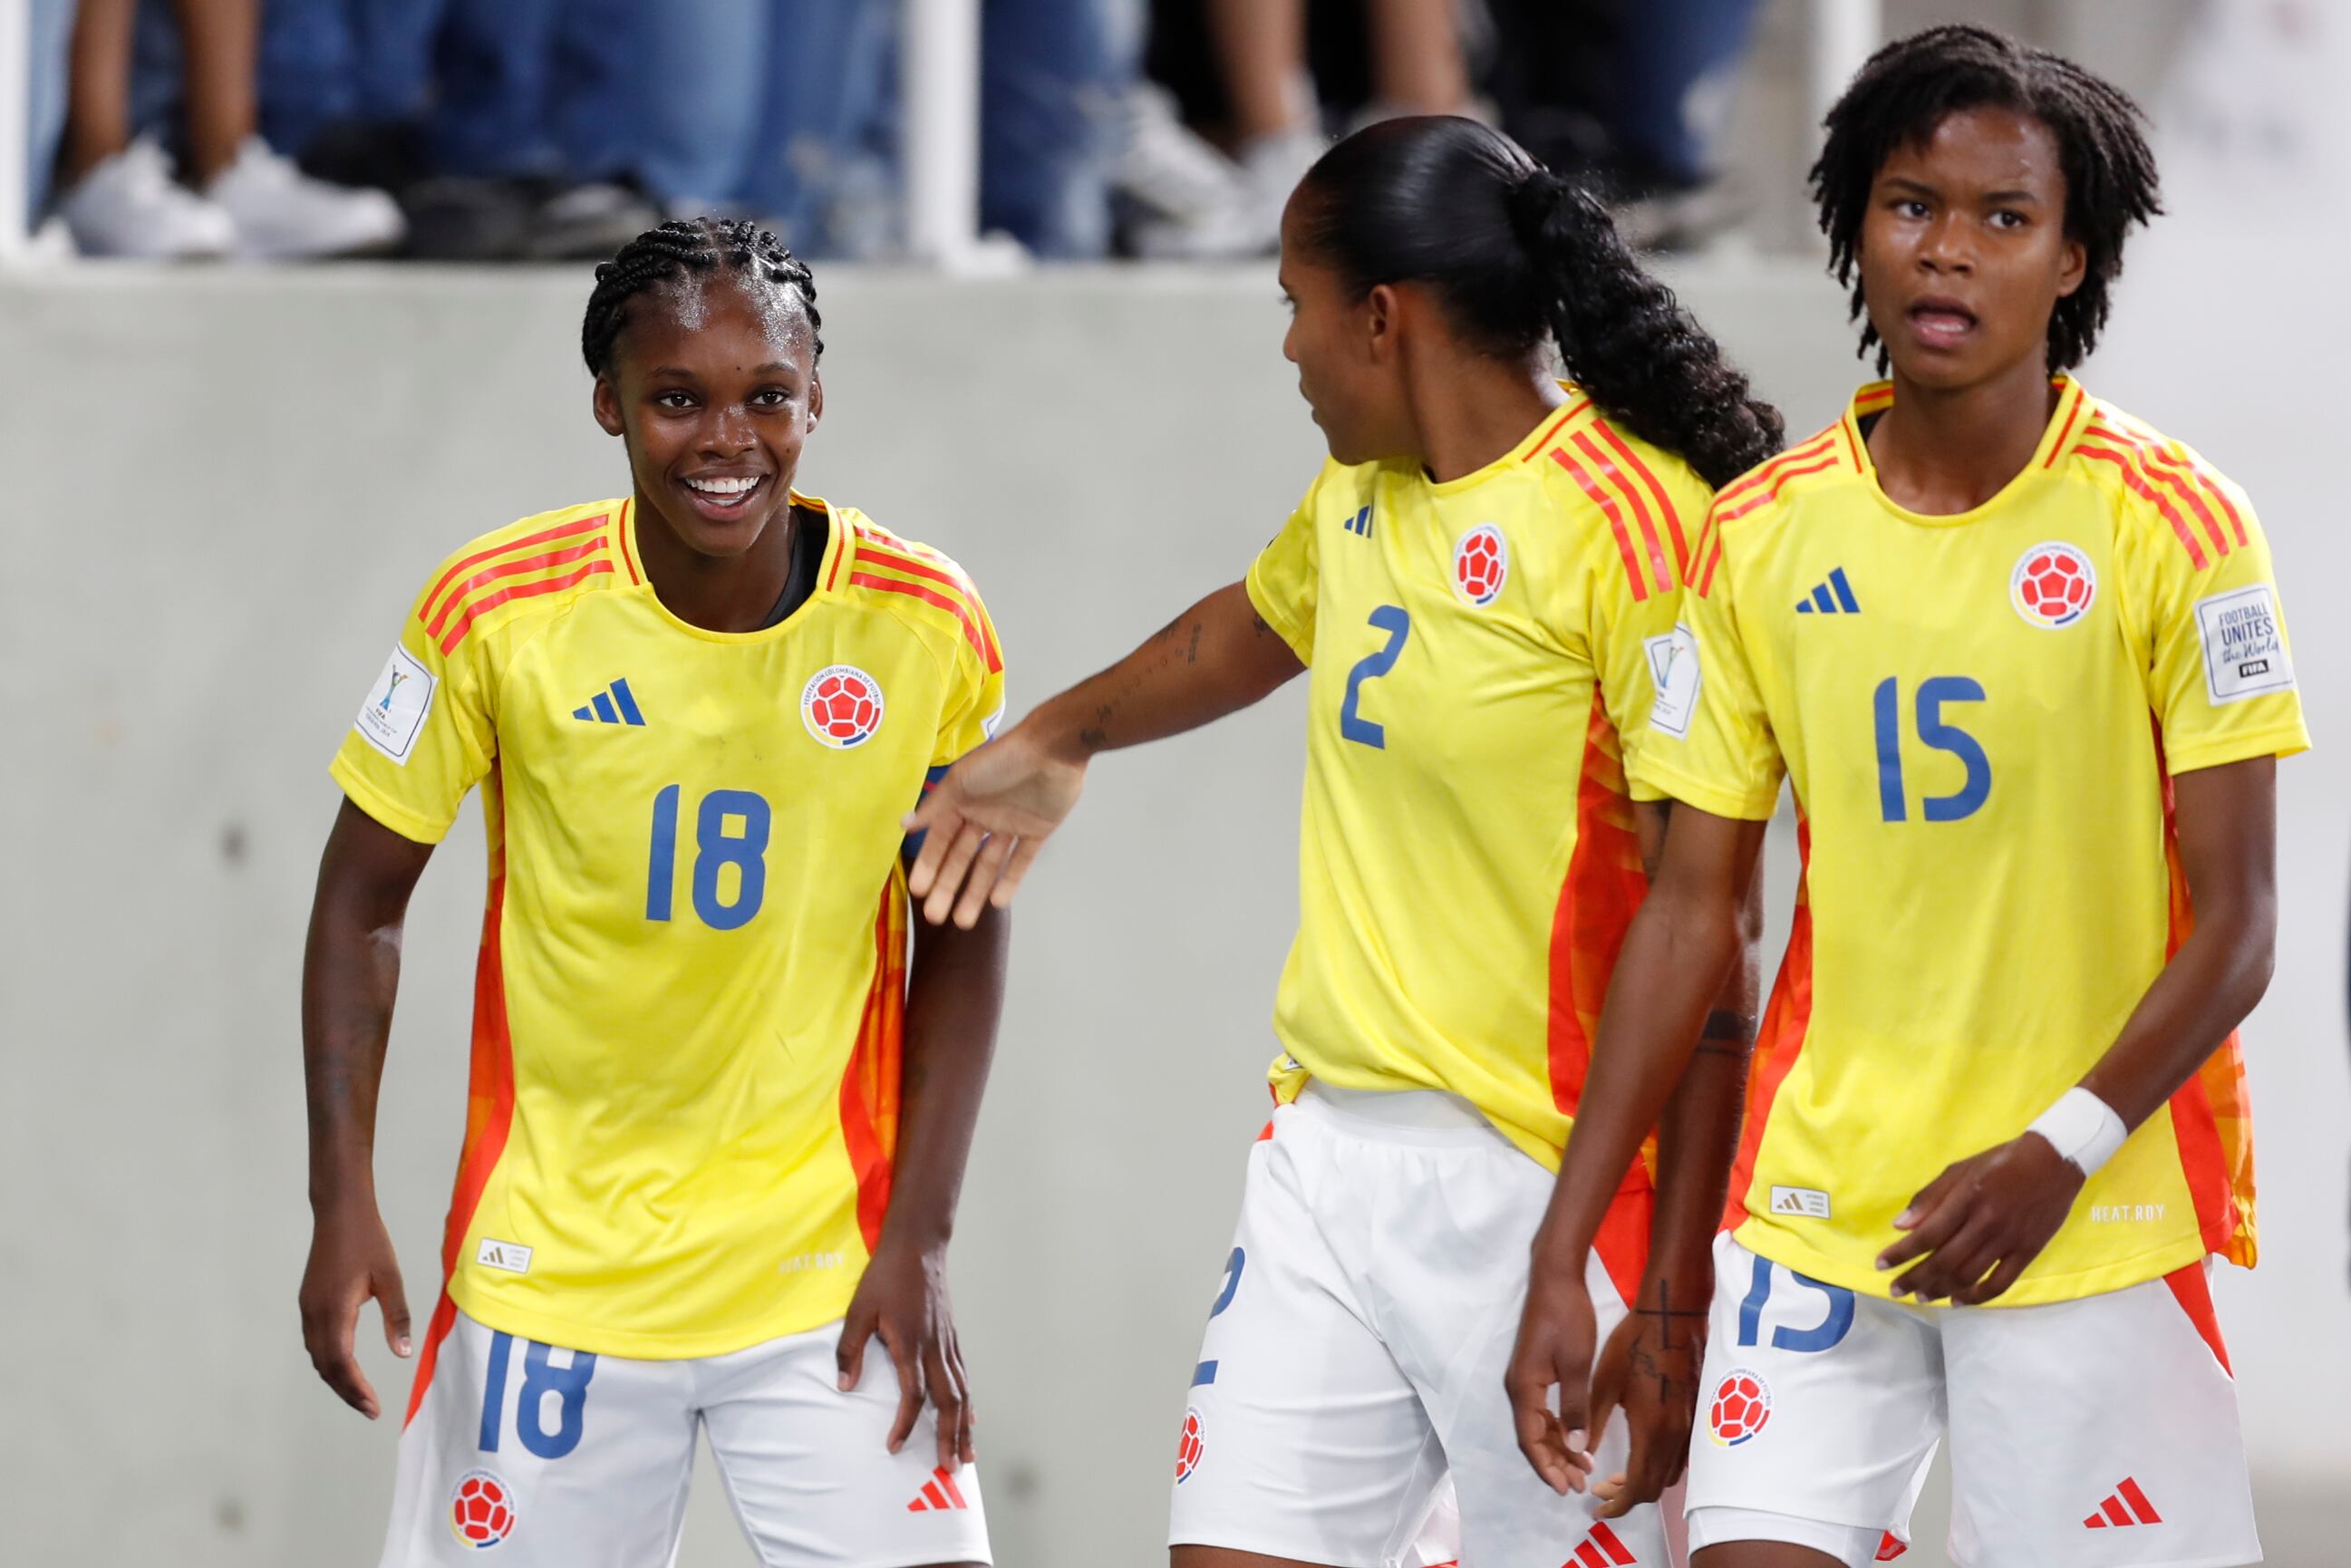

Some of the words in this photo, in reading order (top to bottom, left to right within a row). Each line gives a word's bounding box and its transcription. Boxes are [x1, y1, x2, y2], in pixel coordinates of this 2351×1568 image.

[1341, 605, 1410, 749] 2
[2218, 602, 2269, 626] FOOTBALL
[2220, 616, 2274, 646] UNITES
[1874, 676, 1991, 823] 15
[646, 784, 771, 931] 18
[1737, 1253, 1855, 1353] 15
[479, 1330, 597, 1460] 18
